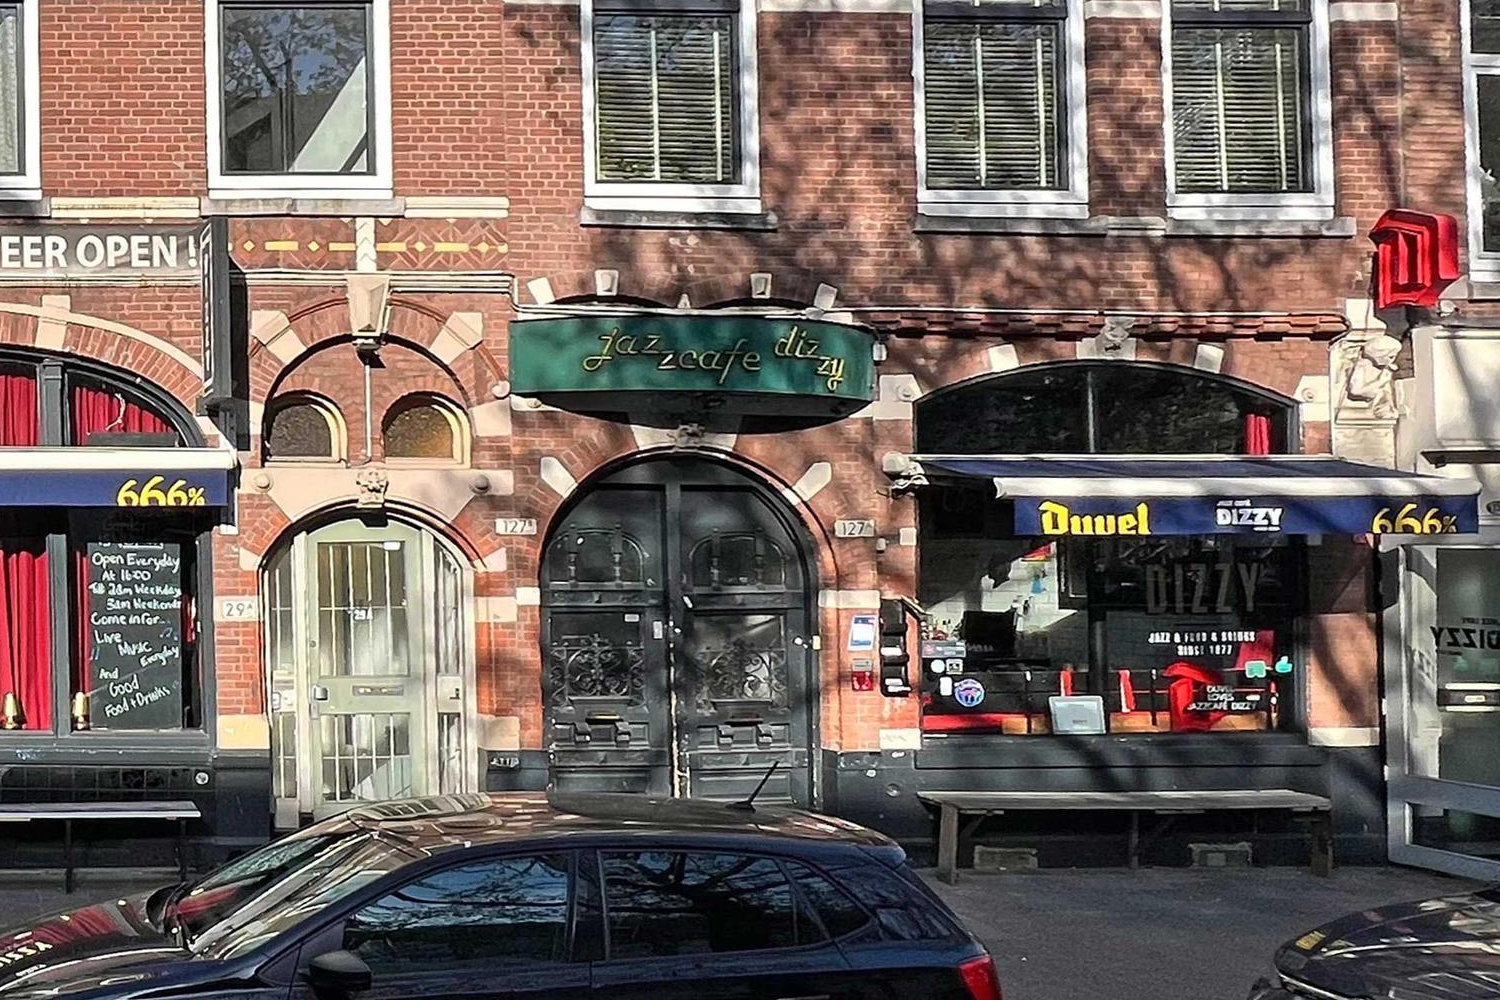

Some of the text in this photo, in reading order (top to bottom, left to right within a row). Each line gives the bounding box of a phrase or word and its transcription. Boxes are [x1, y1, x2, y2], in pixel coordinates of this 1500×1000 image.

[76, 235, 179, 268] OPEN
[1038, 500, 1151, 535] Duvel
[1216, 508, 1282, 525] DIZZY
[92, 552, 180, 573] Open Everyday
[1146, 563, 1258, 613] DIZZY
[91, 612, 127, 625] Come
[109, 674, 139, 697] Good
